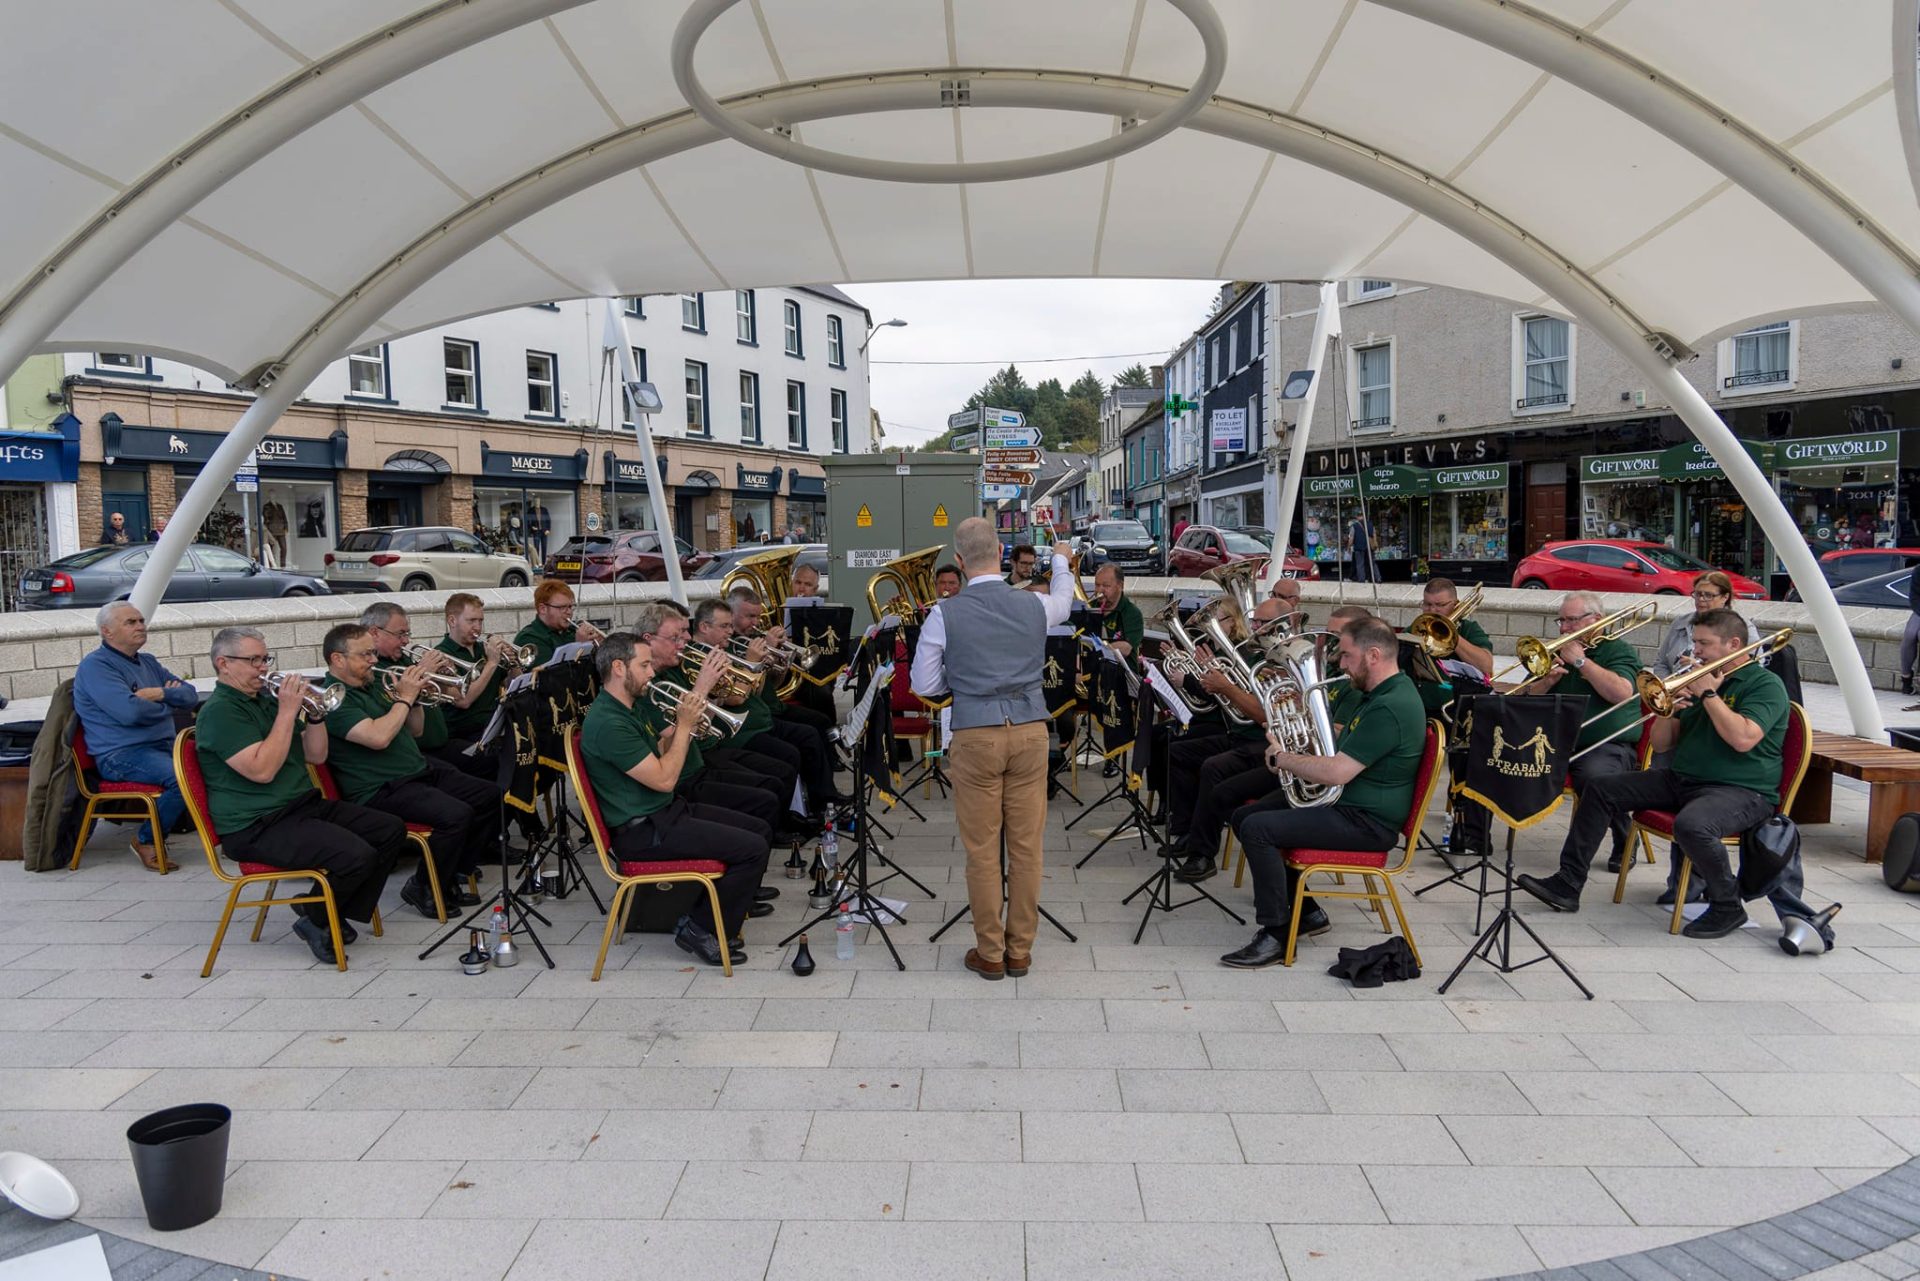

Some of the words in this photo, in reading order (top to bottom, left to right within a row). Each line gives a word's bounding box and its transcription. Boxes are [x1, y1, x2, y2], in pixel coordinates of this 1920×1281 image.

[1215, 412, 1226, 420] TO
[1229, 411, 1243, 420] LET
[256, 440, 297, 455] AGEE
[1785, 440, 1888, 459] GIFTWORLD
[512, 457, 552, 470] MAGEE
[619, 464, 646, 476] MAGE
[1590, 459, 1659, 474] GIFTWORL
[1437, 470, 1500, 484] GIFTWORLD
[854, 551, 878, 559] DIAMOND
[879, 550, 892, 558] EAST
[1486, 758, 1552, 773] STRABANE
